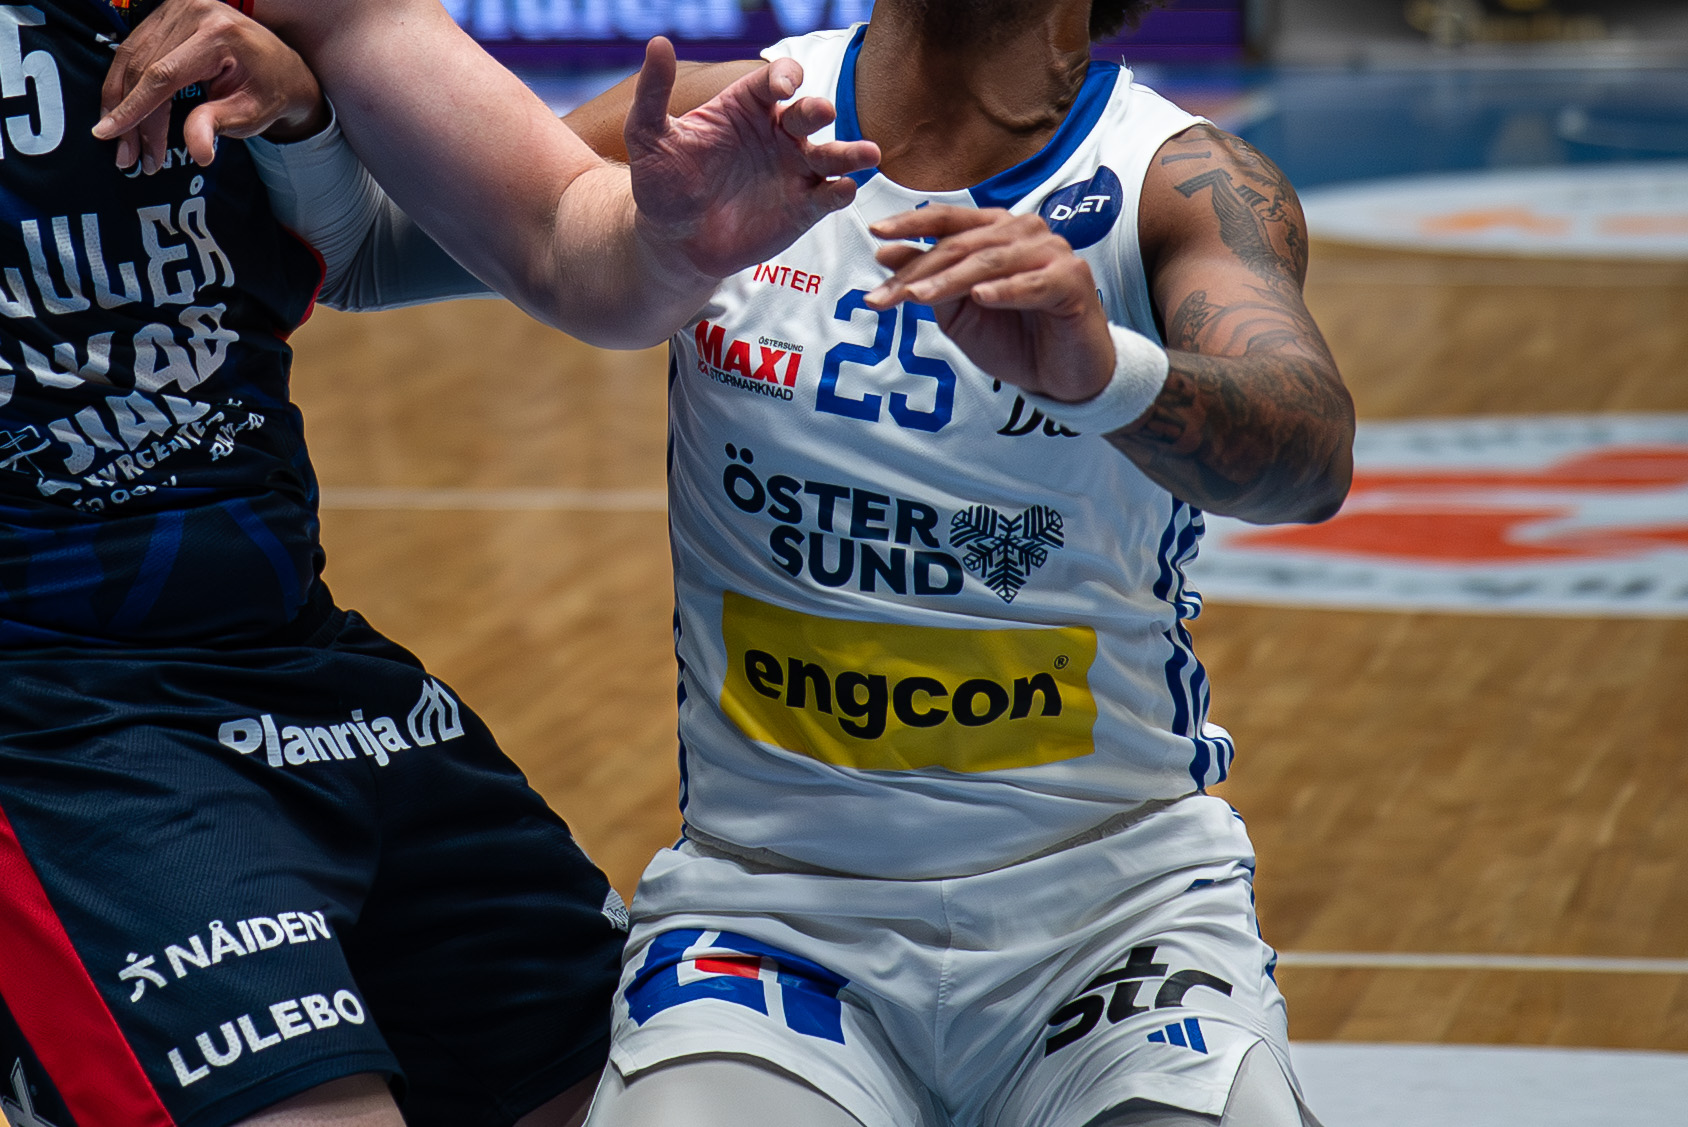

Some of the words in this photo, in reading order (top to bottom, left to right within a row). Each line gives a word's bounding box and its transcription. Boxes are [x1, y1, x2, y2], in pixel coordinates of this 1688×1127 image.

[753, 263, 822, 294] INTER
[695, 319, 803, 388] MAXI
[815, 288, 957, 433] 25
[722, 442, 940, 549] ÖSTER
[769, 524, 964, 596] SUND
[744, 648, 1063, 740] engcon
[164, 909, 331, 979] NÅIDEN
[167, 989, 365, 1088] LULEBO
